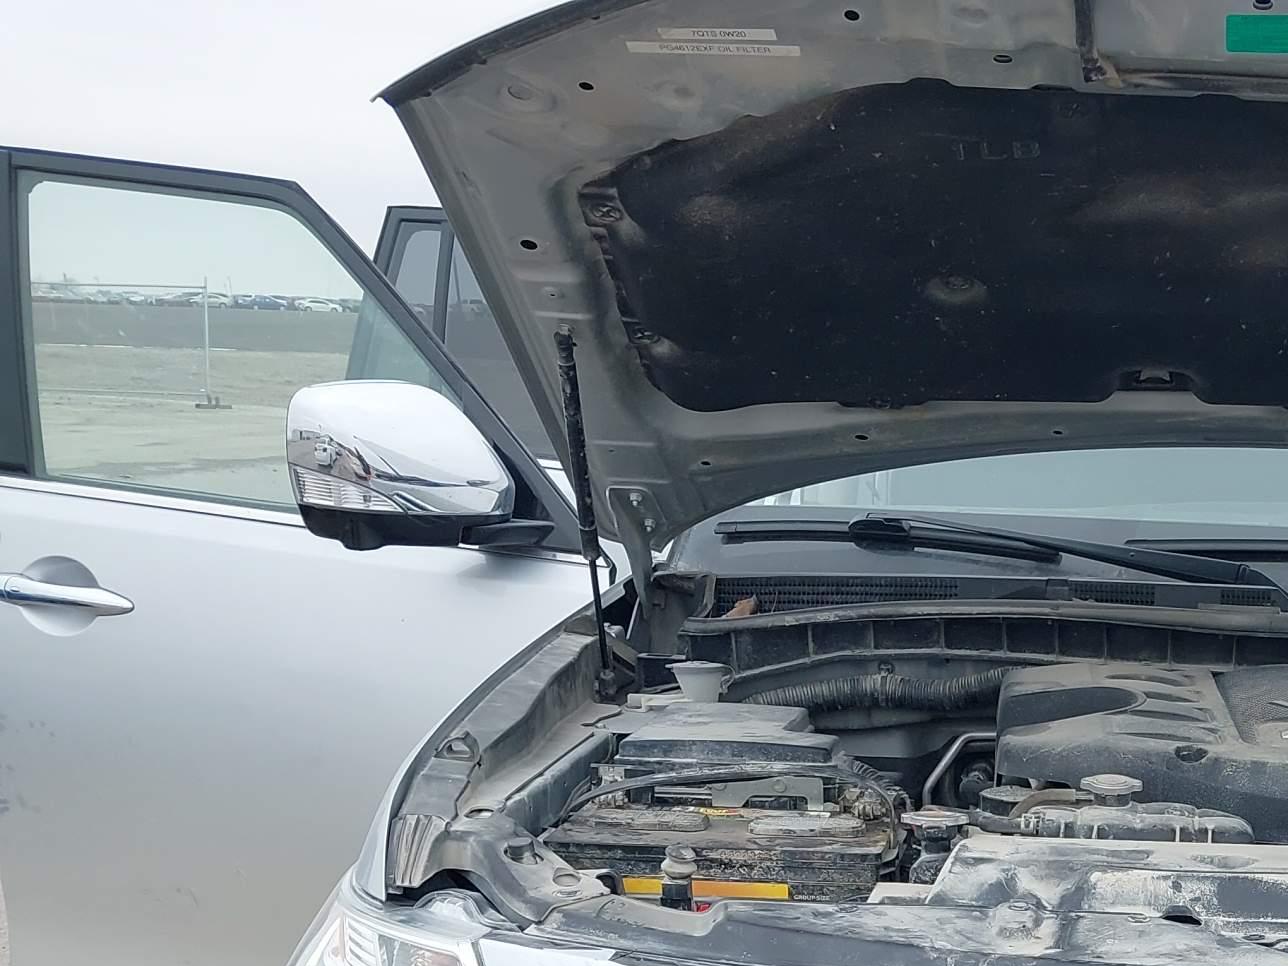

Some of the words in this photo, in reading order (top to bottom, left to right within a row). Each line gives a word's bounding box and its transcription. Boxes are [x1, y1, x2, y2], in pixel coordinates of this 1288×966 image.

[719, 30, 747, 38] 0W20
[717, 45, 734, 53] OIL
[736, 46, 772, 54] FILTER
